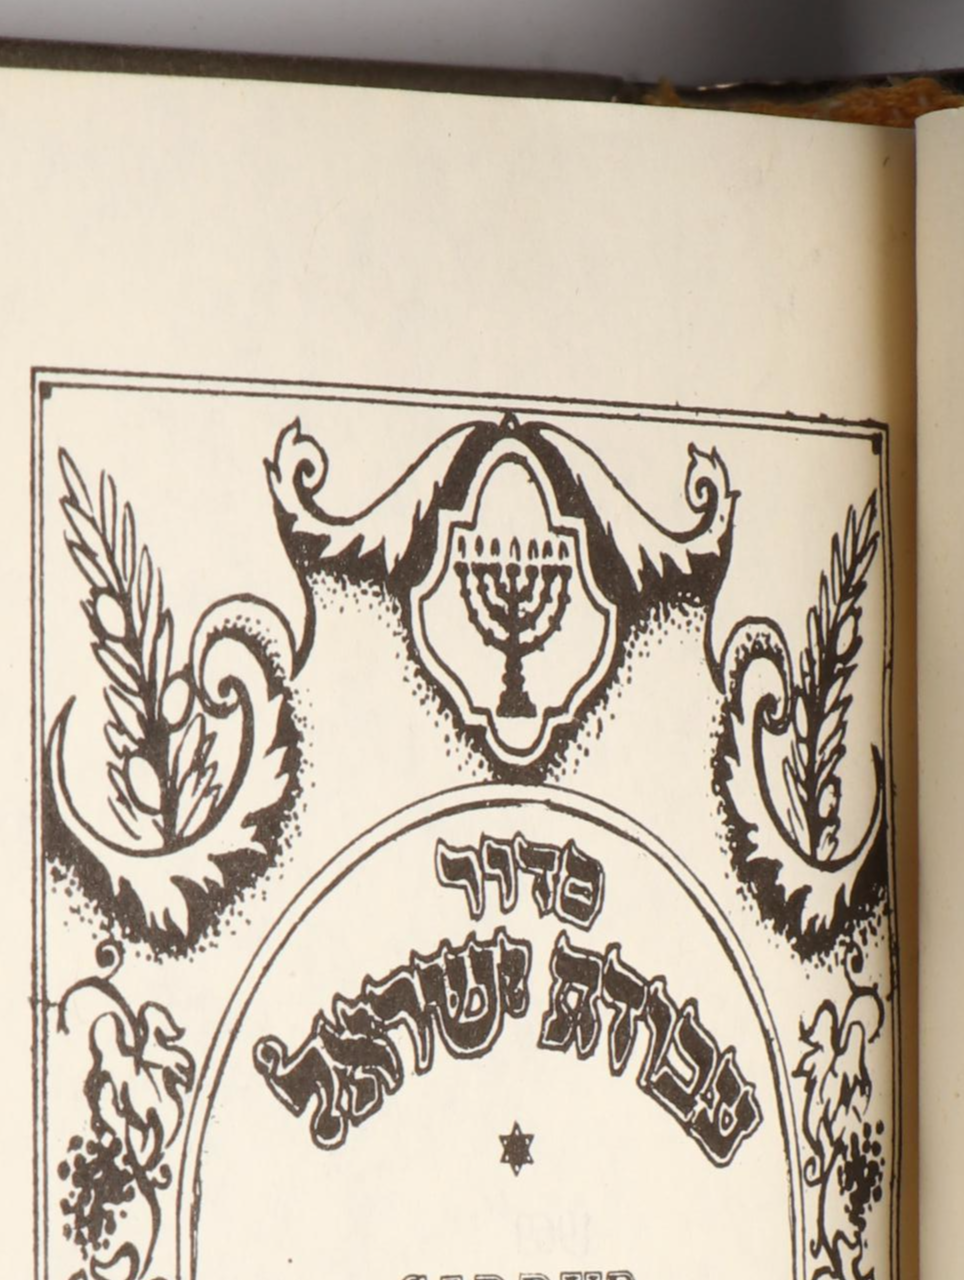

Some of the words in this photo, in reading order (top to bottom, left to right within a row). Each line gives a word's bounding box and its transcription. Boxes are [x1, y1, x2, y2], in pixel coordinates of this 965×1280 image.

[436, 831, 605, 930] סדור
[253, 926, 532, 1150] ישראל
[537, 930, 763, 1167] עבודת
